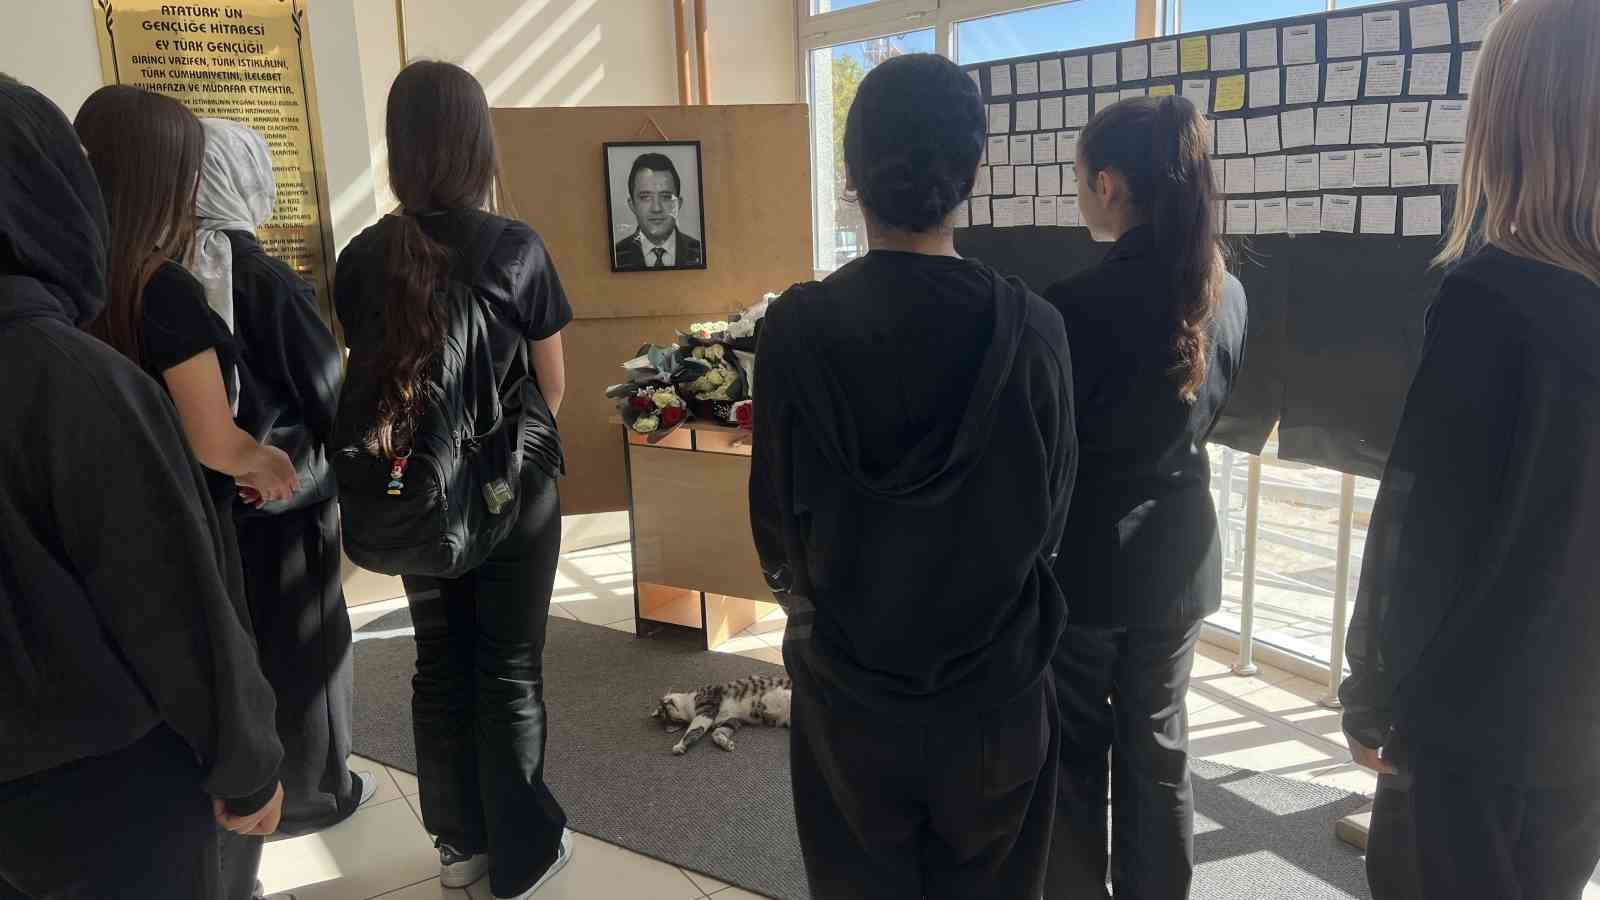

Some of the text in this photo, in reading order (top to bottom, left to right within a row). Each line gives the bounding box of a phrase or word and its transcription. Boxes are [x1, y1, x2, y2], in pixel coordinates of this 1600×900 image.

[224, 5, 243, 19] ÜN
[142, 19, 265, 36] GENÇLİĞE HİTABESİ
[155, 39, 169, 50] EY
[173, 37, 203, 52] TÜRK
[212, 56, 236, 67] TÜRK
[141, 67, 166, 79] TÜRK
[188, 83, 201, 92] VE
